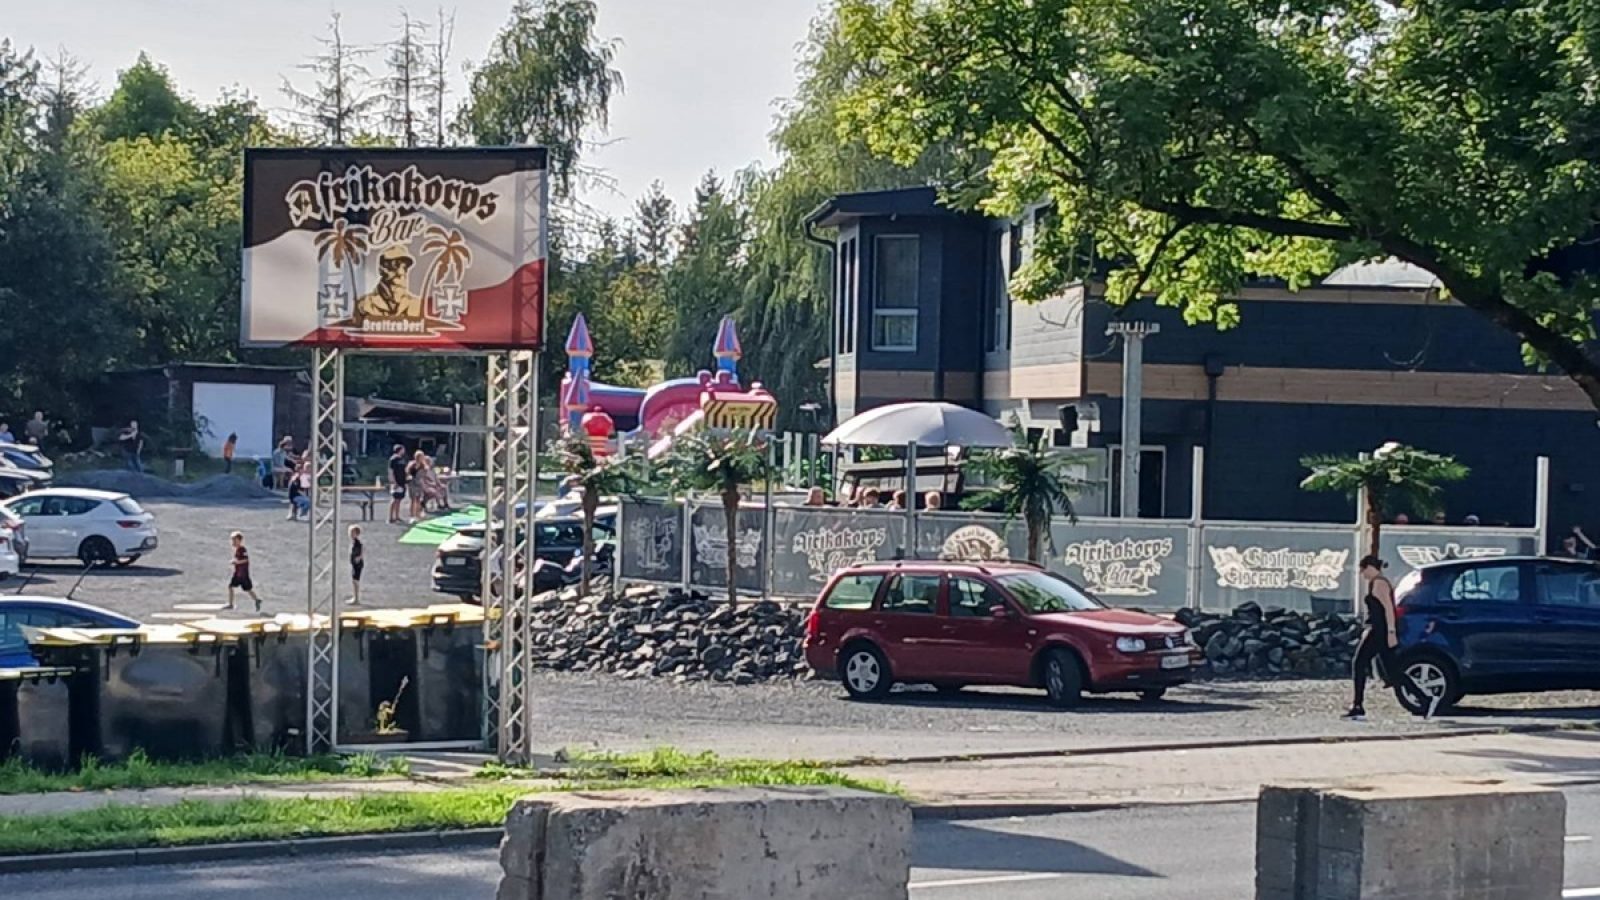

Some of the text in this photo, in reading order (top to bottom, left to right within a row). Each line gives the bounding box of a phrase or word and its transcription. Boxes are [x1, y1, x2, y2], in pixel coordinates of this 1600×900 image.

[285, 165, 500, 227] Afrikakorps
[369, 209, 424, 245] Bar
[792, 527, 887, 555] Afrikakorps
[1064, 537, 1173, 567] Afrikakorps
[1103, 561, 1144, 587] Bar
